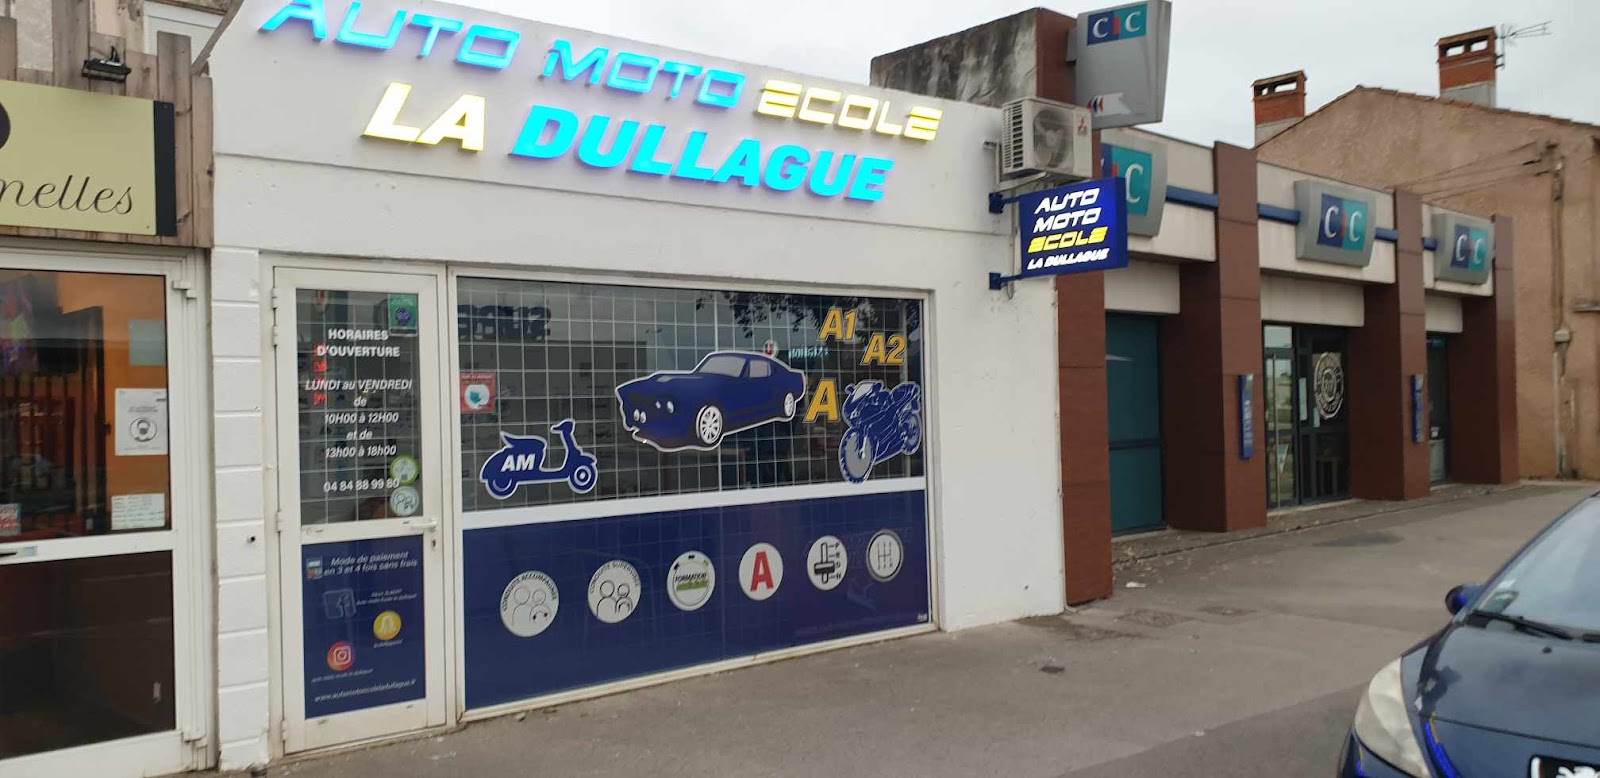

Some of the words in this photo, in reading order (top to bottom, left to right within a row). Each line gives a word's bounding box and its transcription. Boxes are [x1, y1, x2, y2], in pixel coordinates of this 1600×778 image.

[1092, 11, 1141, 39] CIC
[258, 0, 521, 69] AUTO
[540, 38, 746, 108] MOTO
[757, 79, 943, 142] ECOLE
[361, 82, 486, 151] LA
[508, 104, 895, 202] DULLAGUE
[1034, 188, 1100, 214] AUTO
[1033, 207, 1102, 233] MOTO
[1324, 205, 1363, 242] CIC
[1028, 226, 1109, 253] ECOLE
[1456, 234, 1484, 264] CIC
[1027, 256, 1044, 270] LA
[1044, 248, 1110, 268] DULLAGUE
[328, 328, 389, 341] HORAIRES
[818, 306, 858, 341] A1
[317, 345, 401, 357] D'OUVERTURE
[860, 333, 907, 366] A2
[305, 379, 340, 391] LUNDI
[342, 381, 356, 390] au
[358, 379, 413, 391] VENDREDI
[353, 396, 367, 407] de
[802, 377, 841, 424] A
[325, 412, 357, 424] 10H00
[358, 412, 366, 423] à
[368, 412, 399, 423] 12H00
[346, 430, 357, 440] et
[359, 429, 373, 440] de
[325, 446, 357, 458] 13h00
[358, 445, 366, 457] à
[367, 444, 397, 456] 18h00
[500, 453, 536, 472] AM
[323, 481, 337, 492] 04
[340, 480, 353, 491] 84
[355, 479, 369, 491] 88
[371, 478, 384, 489] 99
[386, 477, 400, 488] 80
[323, 568, 336, 577] en
[344, 565, 353, 574] et
[354, 564, 361, 573] 4
[361, 563, 378, 573] fois
[379, 562, 398, 570] sans
[399, 559, 418, 568] frais
[330, 557, 356, 566] Mode
[358, 555, 369, 564] de
[369, 551, 409, 563] paiement
[750, 551, 775, 591] A
